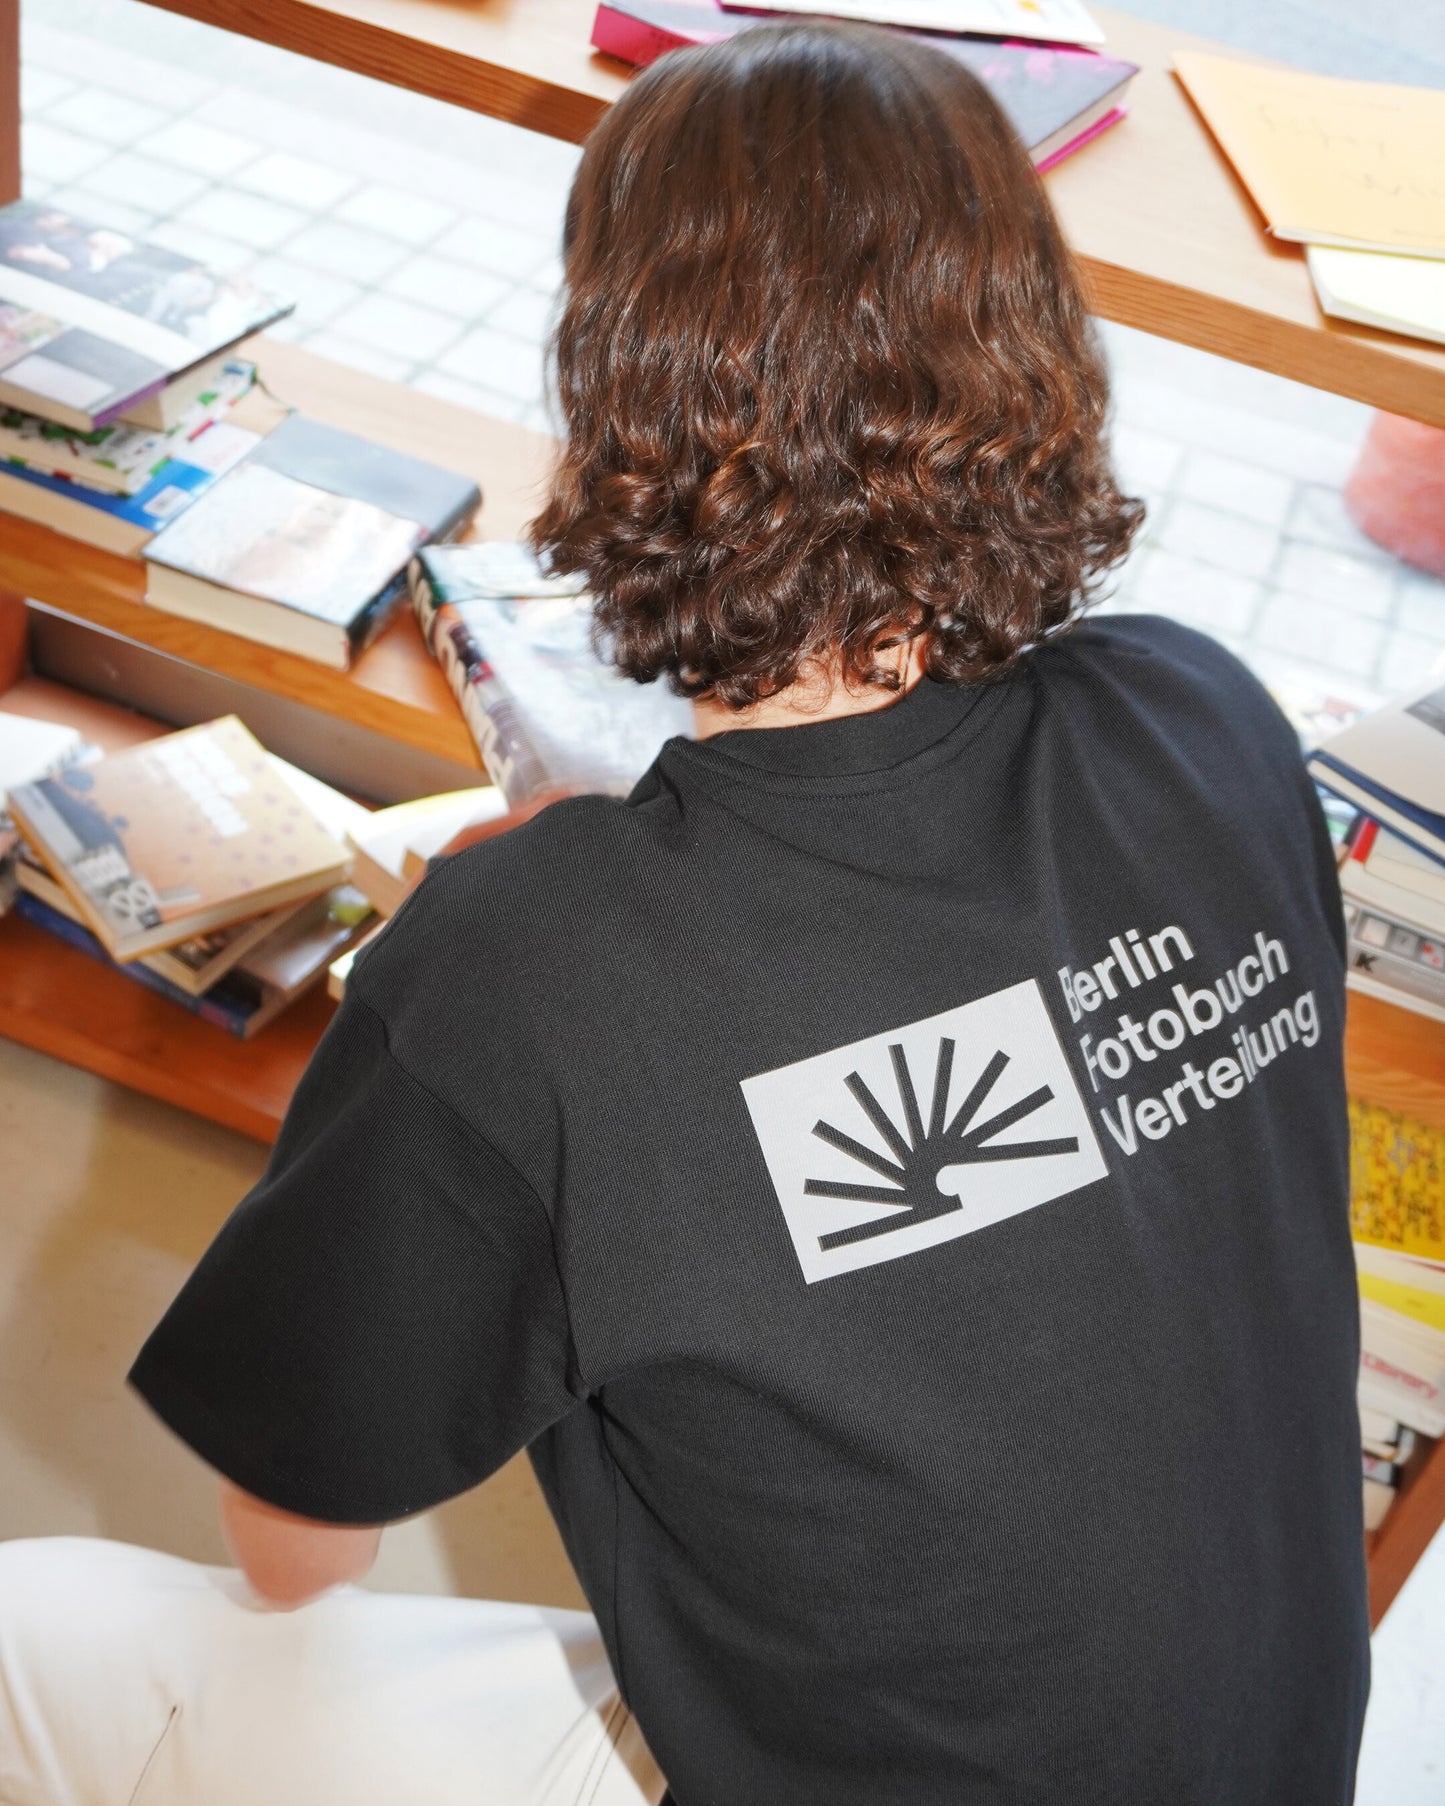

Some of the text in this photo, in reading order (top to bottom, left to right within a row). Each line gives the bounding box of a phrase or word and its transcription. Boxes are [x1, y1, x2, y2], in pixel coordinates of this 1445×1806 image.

[1057, 925, 1194, 1023] Berlin
[1079, 931, 1290, 1093] Fotobuch
[1100, 991, 1321, 1156] Verteilung
